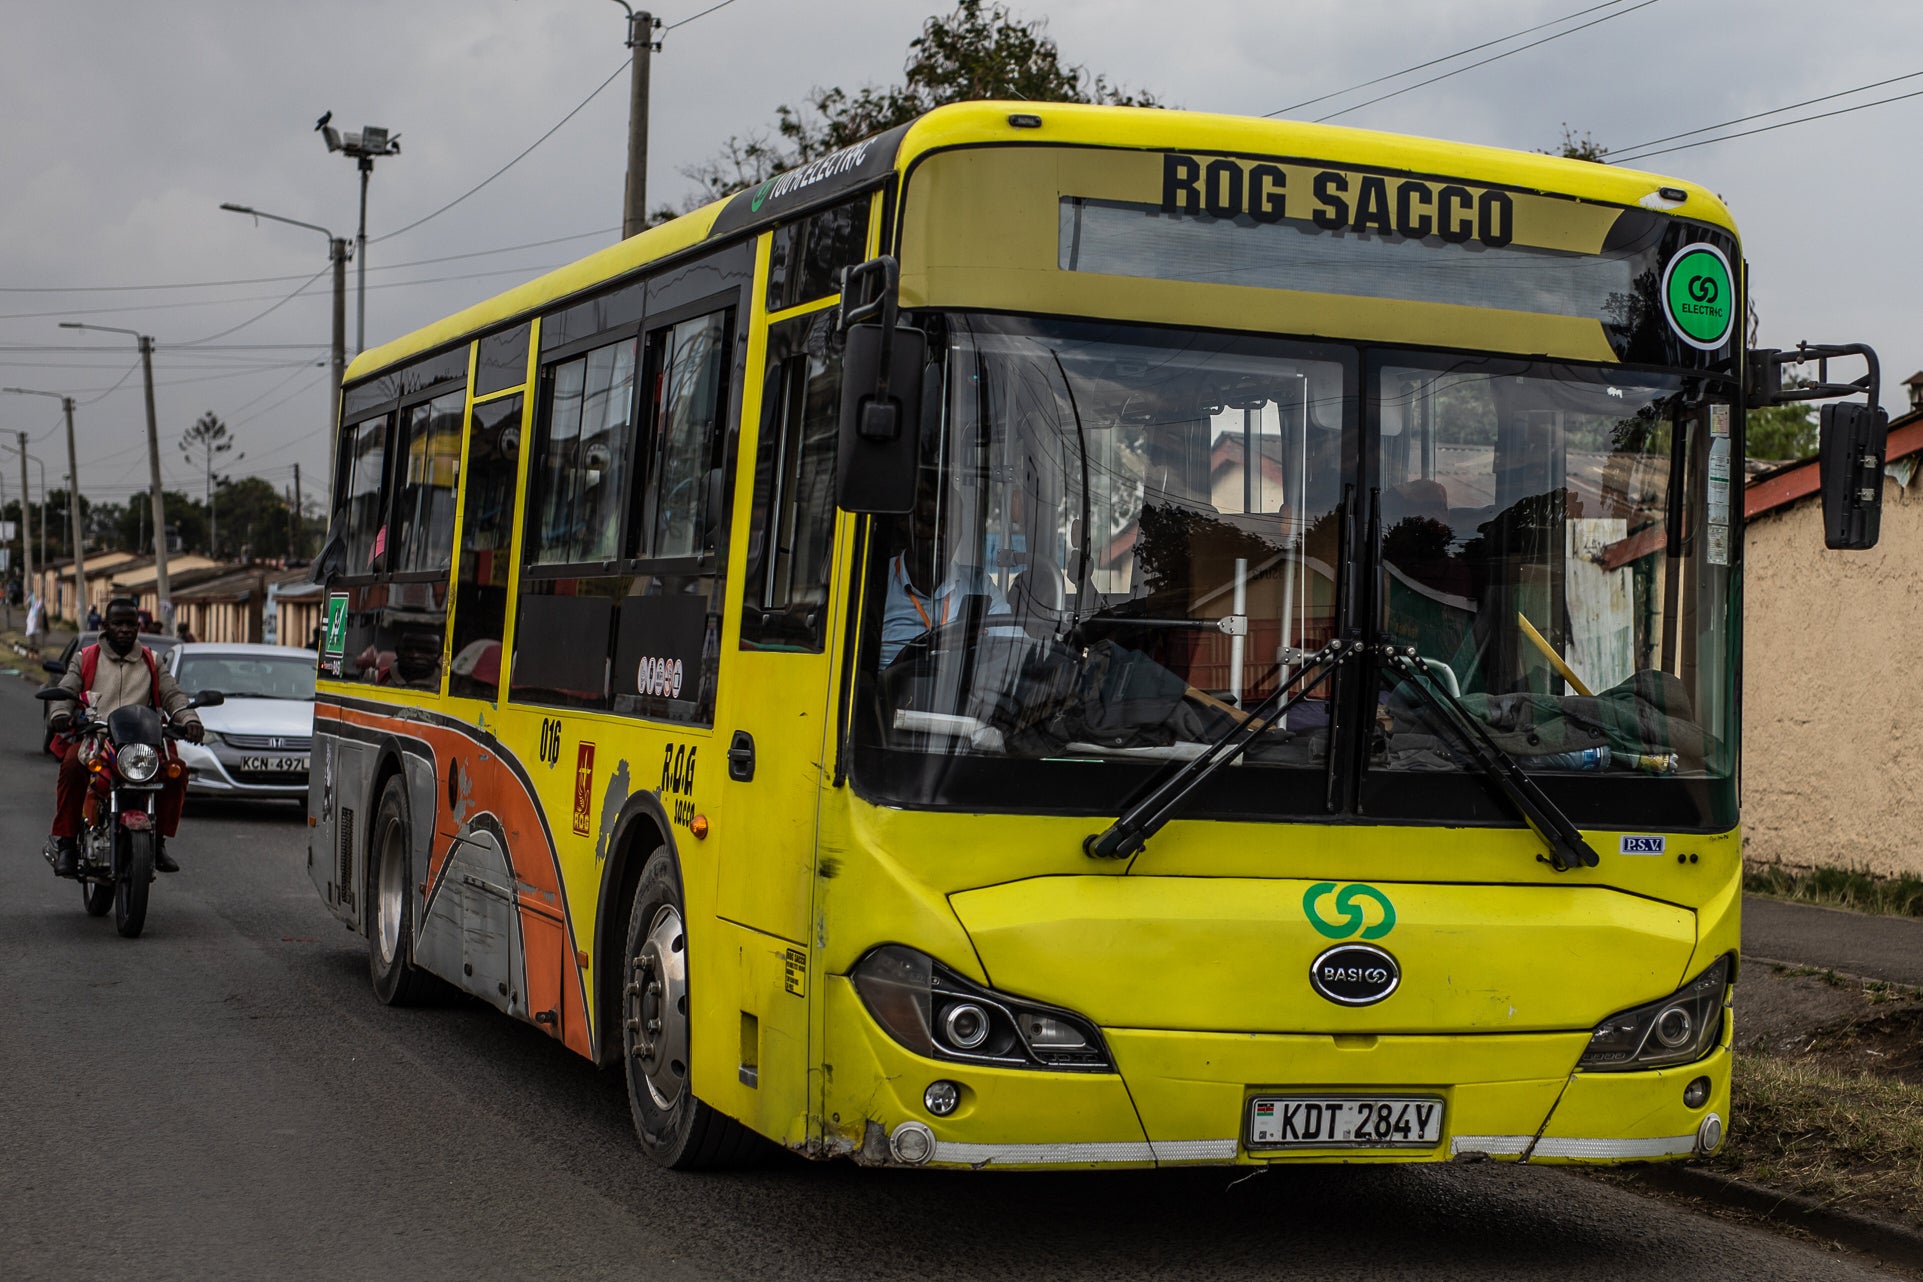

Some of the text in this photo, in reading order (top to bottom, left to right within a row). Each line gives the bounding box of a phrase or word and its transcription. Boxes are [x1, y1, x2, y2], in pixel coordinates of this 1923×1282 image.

[1162, 155, 1514, 248] ROG SACCO
[540, 717, 562, 764] 016
[243, 756, 269, 770] KCN
[1626, 838, 1660, 851] P.S.V.
[1281, 1103, 1434, 1140] KDT 284Y
